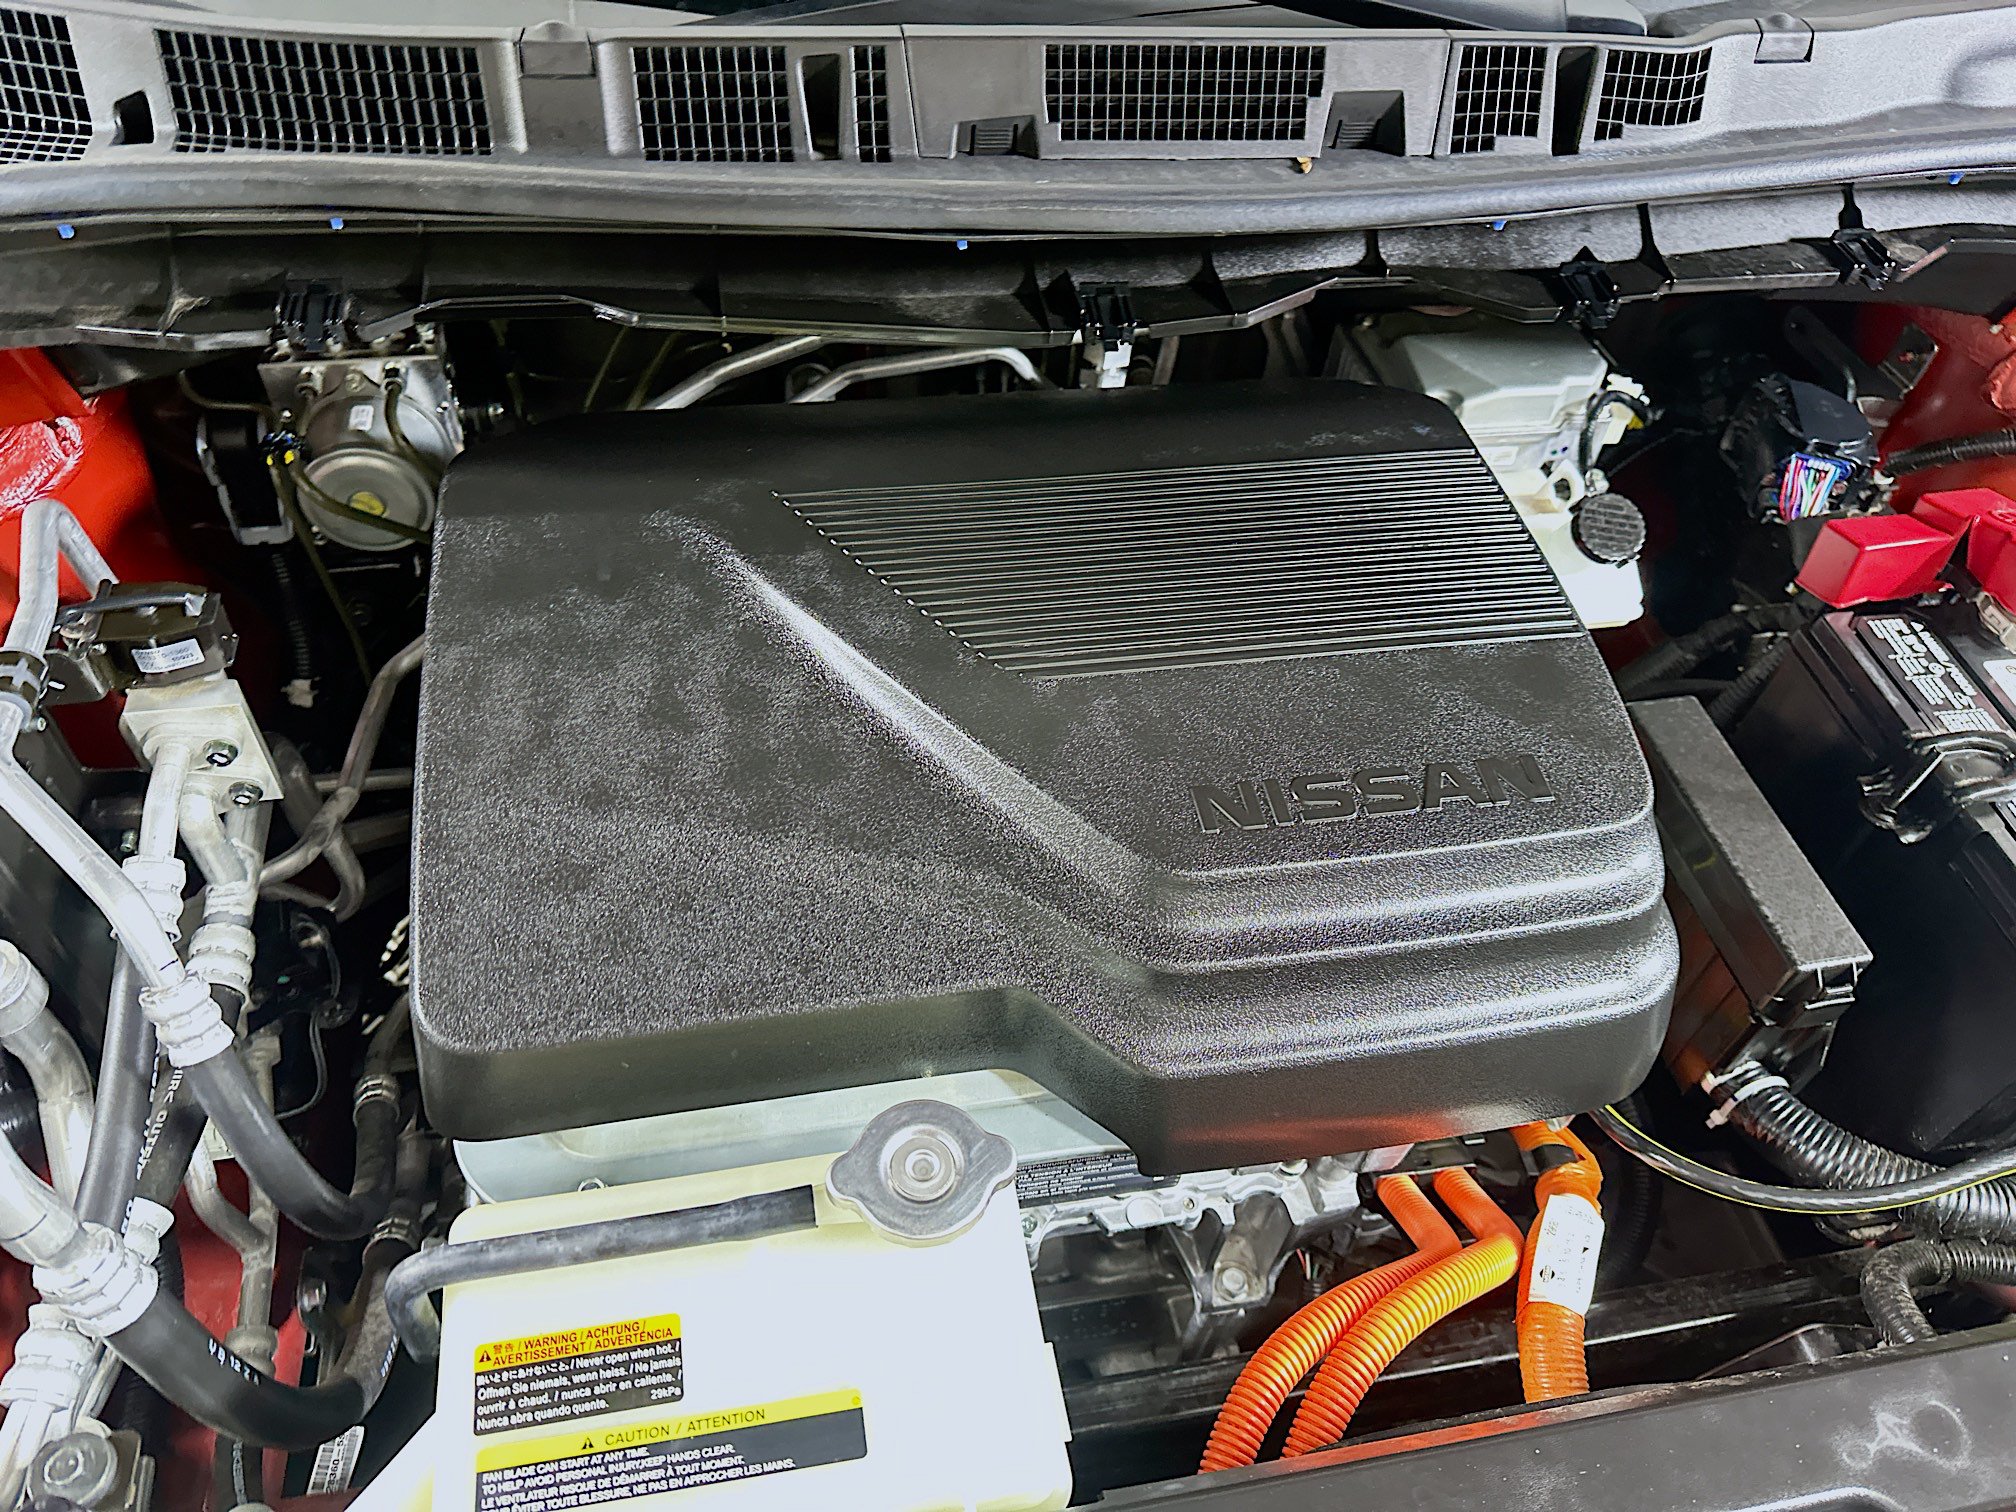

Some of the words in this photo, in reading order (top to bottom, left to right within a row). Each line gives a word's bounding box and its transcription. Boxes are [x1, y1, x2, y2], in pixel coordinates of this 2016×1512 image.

[1191, 754, 1556, 834] NISSAN
[493, 1341, 586, 1367] AVERTISSEMENT
[524, 1332, 578, 1350] WARNING
[586, 1322, 640, 1340] ACHTUNG
[576, 1355, 604, 1369] Never
[605, 1352, 629, 1365] open
[630, 1347, 656, 1361] when
[656, 1343, 675, 1356] hot.
[476, 1400, 507, 1416] ouvrir
[518, 1392, 552, 1408] chaud.
[561, 1386, 592, 1401] nunca
[593, 1381, 618, 1395] abrir
[618, 1380, 632, 1391] en
[634, 1372, 676, 1388] caliente.
[512, 1382, 529, 1395] Sie
[530, 1374, 572, 1392] niemals,
[572, 1371, 599, 1384] wenn
[599, 1366, 628, 1380] heiss.
[649, 1356, 682, 1374] jamais
[650, 1386, 682, 1400] 29kPa
[476, 1415, 510, 1430] Nunca
[510, 1411, 534, 1425] abra
[534, 1403, 571, 1422] quando
[572, 1398, 610, 1416] quente.
[605, 1425, 670, 1446] CAUTION
[687, 1408, 766, 1433] ATTENTION
[481, 1497, 495, 1510] LE
[495, 1486, 559, 1507] VENTILATEUR
[559, 1479, 598, 1497] RISQUE
[597, 1477, 612, 1490] DE
[612, 1466, 666, 1488] DÉMARRER
[675, 1461, 700, 1475] TOUT
[701, 1455, 746, 1472] MOMENT.
[482, 1470, 502, 1484] FAN
[503, 1465, 536, 1480] BLADE
[537, 1461, 559, 1475] CAN
[559, 1456, 591, 1471] START
[591, 1454, 604, 1465] AT
[604, 1450, 624, 1463] ANY
[482, 1483, 497, 1496] TO
[497, 1479, 524, 1494] HELP
[524, 1474, 555, 1489] AVOID
[555, 1466, 608, 1483] PERSONAL
[667, 1448, 701, 1465] HANDS
[701, 1443, 736, 1458] CLEAR.
[545, 1495, 579, 1511] TOUTE
[633, 1484, 648, 1496] NE
[649, 1481, 668, 1494] PAS
[669, 1478, 684, 1490] EN
[684, 1467, 744, 1487] APPROCHER
[744, 1463, 764, 1477] LES
[763, 1458, 797, 1474] MAINS.
